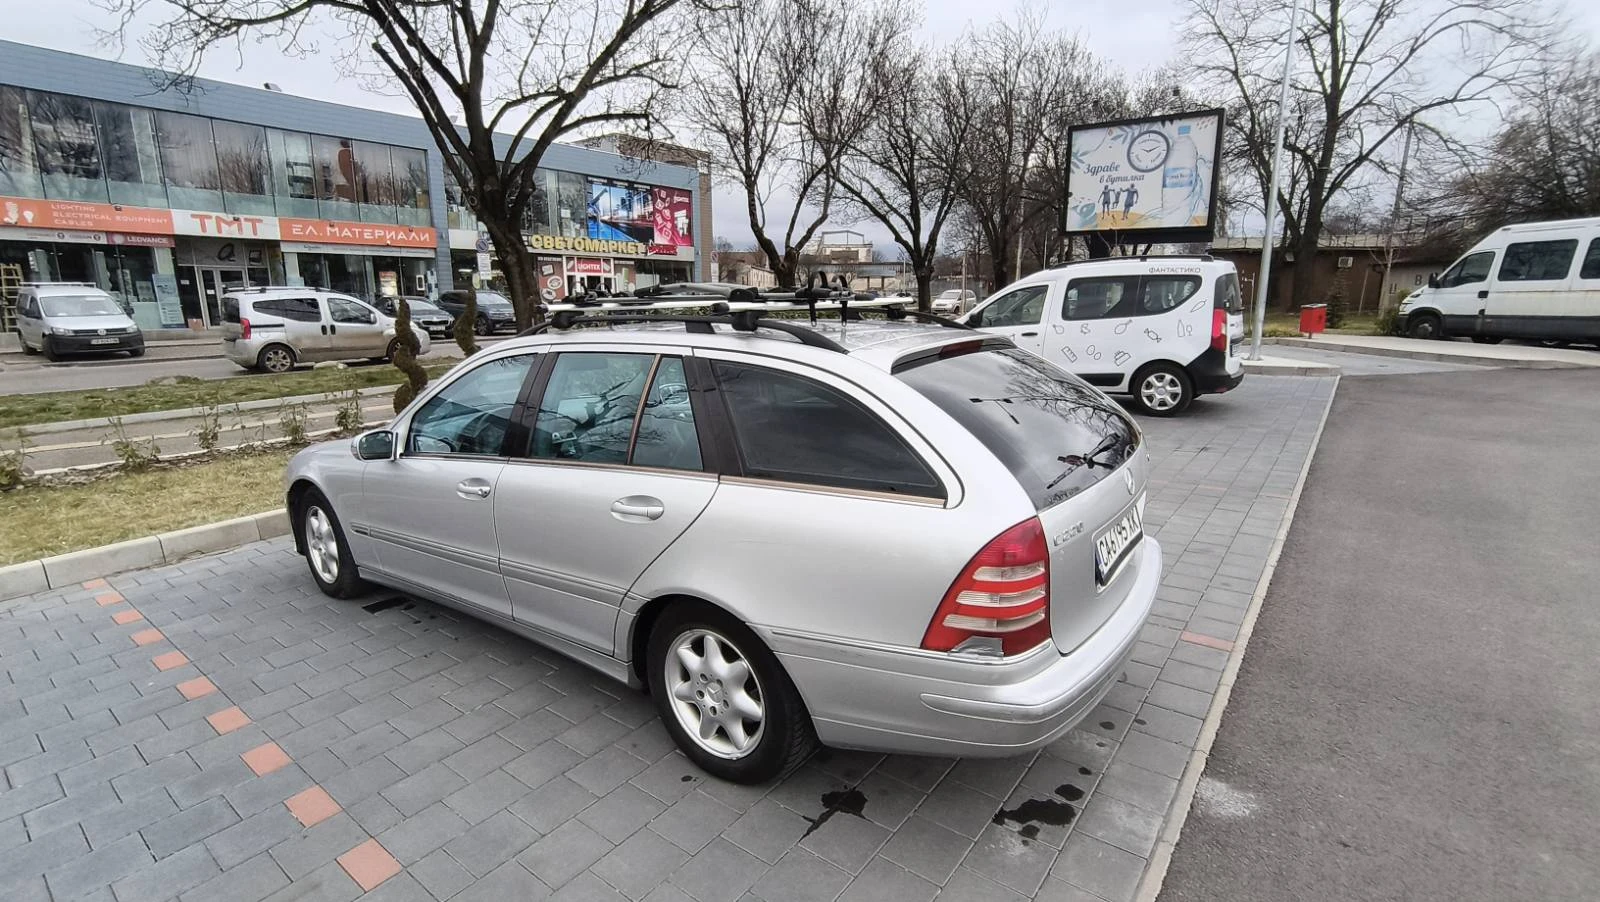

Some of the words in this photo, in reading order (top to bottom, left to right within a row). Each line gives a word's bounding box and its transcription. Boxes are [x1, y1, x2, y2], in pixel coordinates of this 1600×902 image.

[1083, 162, 1120, 176] Здраве
[51, 203, 95, 212] LIGHTING
[52, 211, 112, 221] ELECTRICAL
[115, 215, 168, 224] EQUIPMENT
[127, 235, 169, 244] LEDVANCE
[292, 224, 323, 237] ЕЛ.
[326, 226, 430, 242] МАТЕРИАЛИ
[531, 234, 646, 255] СВЕТОМАРКЕТ
[1148, 266, 1201, 274] ФАНТАСТИКО
